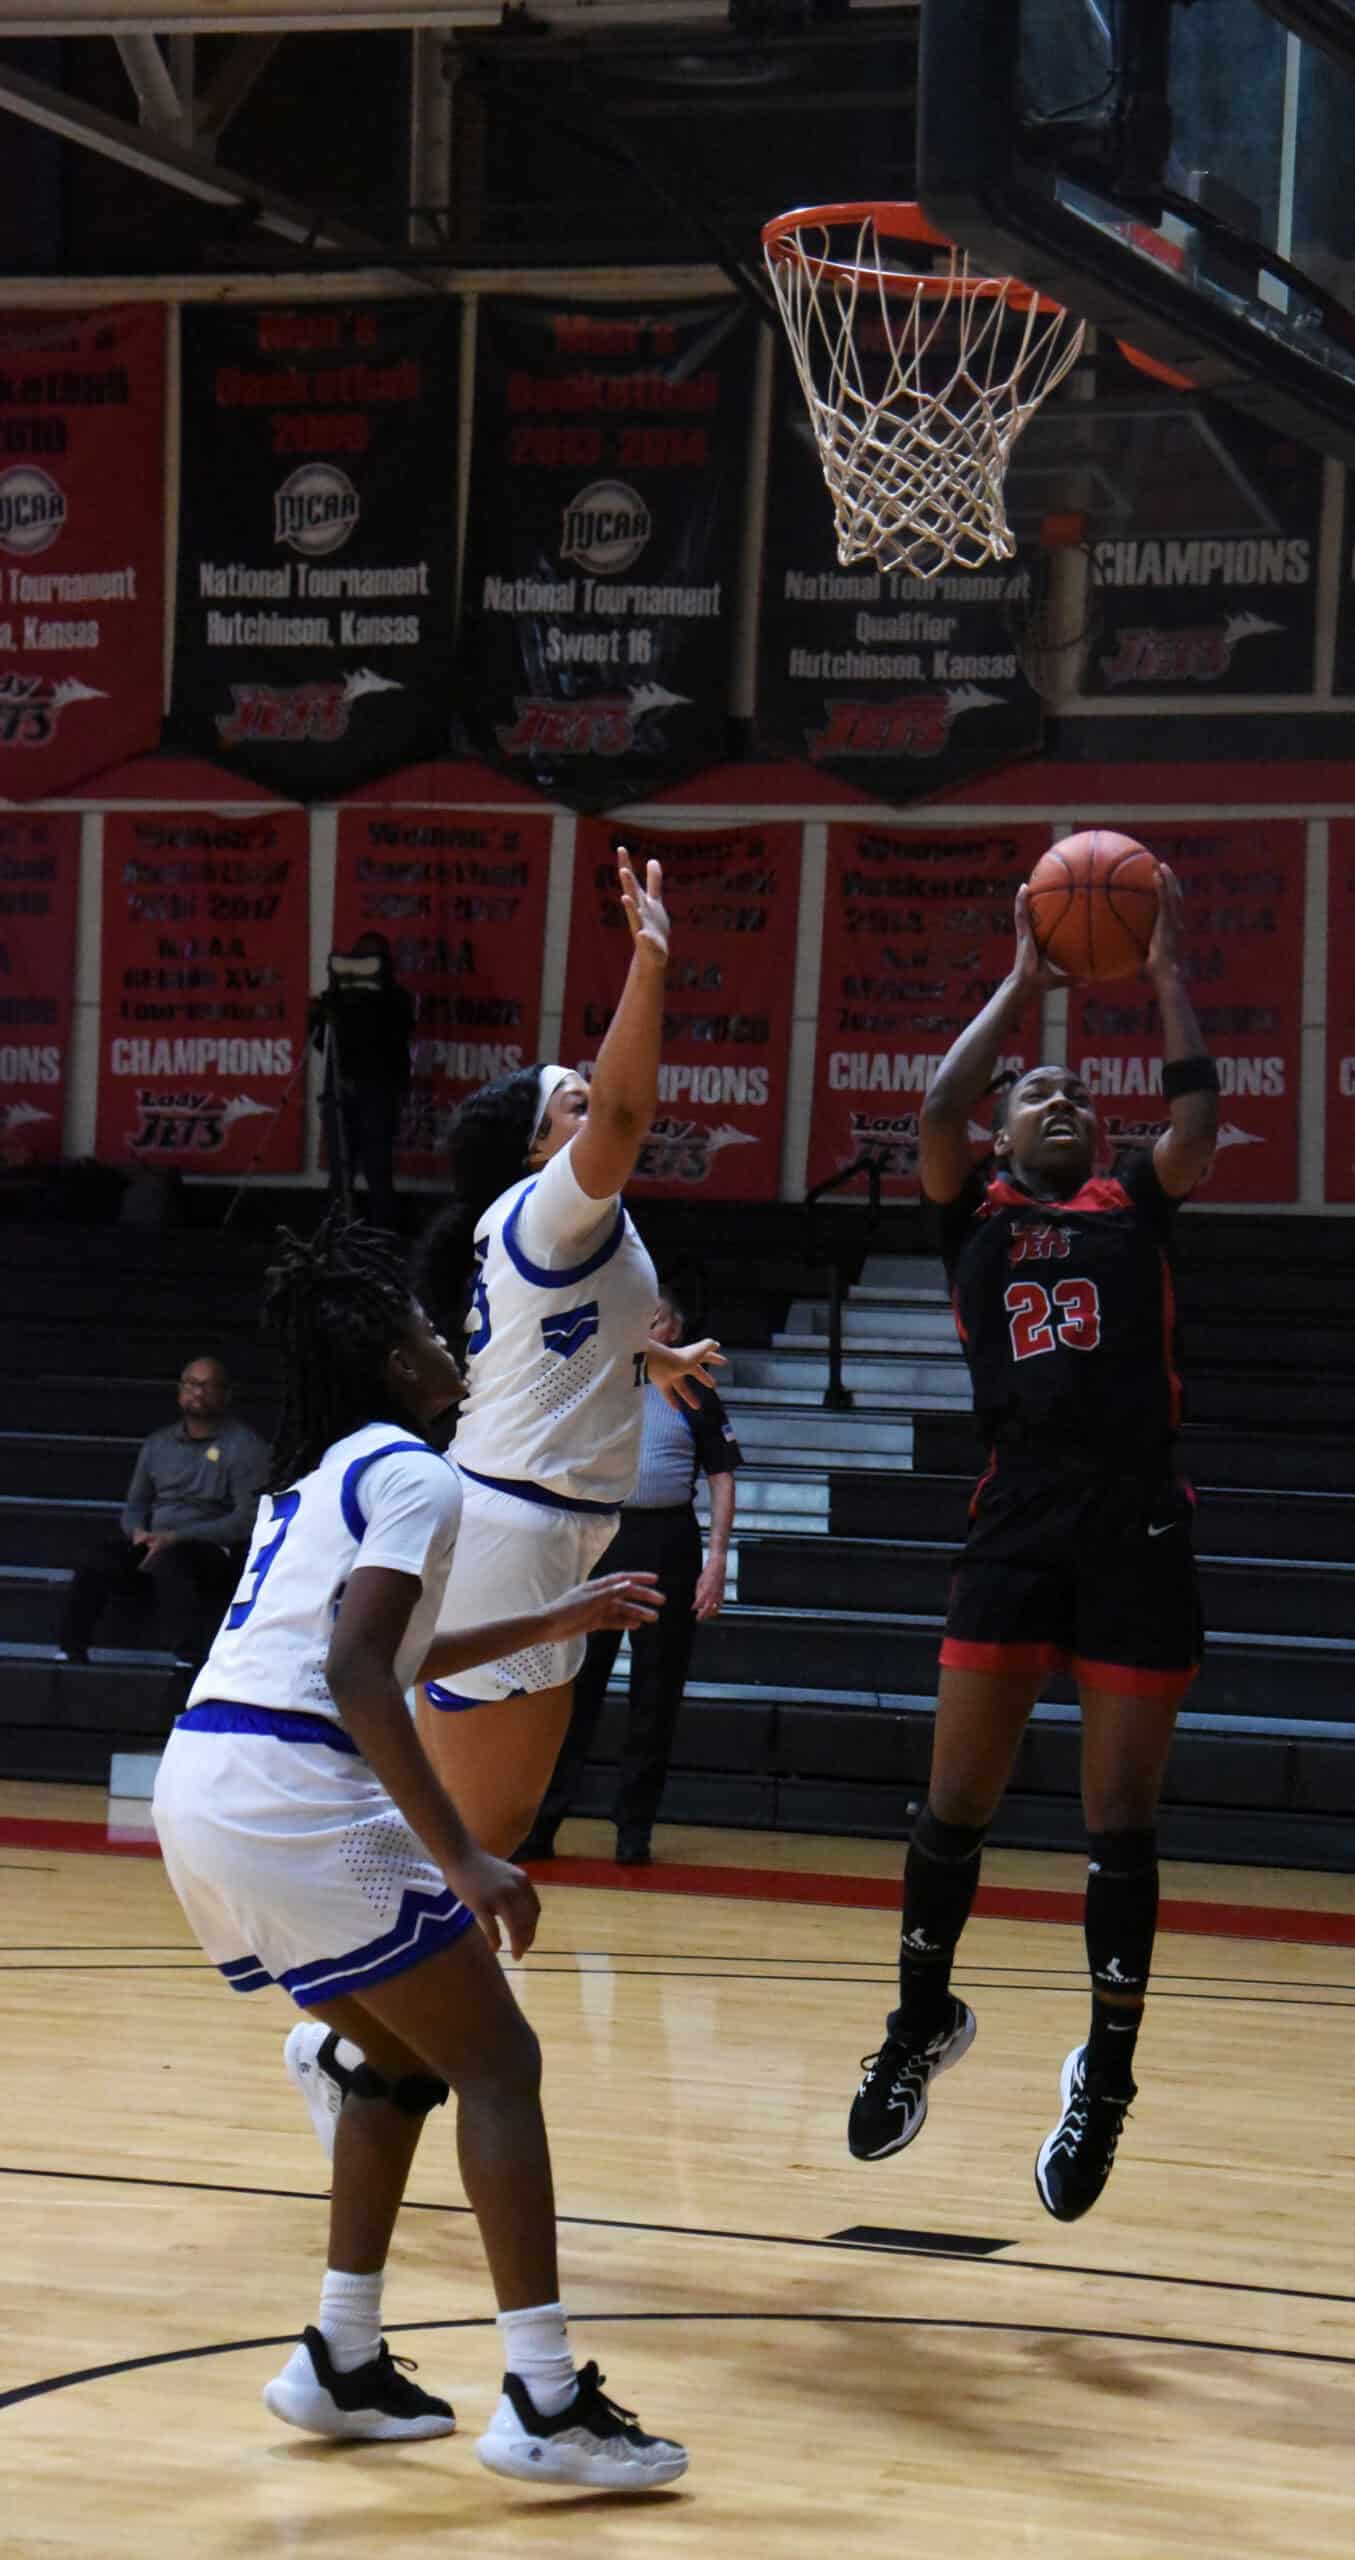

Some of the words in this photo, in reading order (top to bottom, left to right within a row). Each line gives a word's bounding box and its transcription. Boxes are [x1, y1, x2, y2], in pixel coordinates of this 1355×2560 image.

[200, 562, 292, 599] National
[296, 562, 430, 599] Tournament
[1093, 541, 1310, 586] CHAMPIONS
[8, 566, 137, 604] Tournament
[482, 576, 577, 613] National
[582, 579, 722, 616] Tournament
[784, 570, 881, 600] National
[23, 616, 100, 649] Kansas
[206, 610, 336, 648] Hutchinson,
[340, 609, 420, 646] Kansas
[544, 627, 620, 663] Sweet
[627, 629, 652, 664] 16
[856, 611, 957, 644] Qualifier
[789, 649, 928, 680] Hutchinson,
[932, 650, 1017, 680] Kansas
[110, 1037, 293, 1076] CHAMPIONS
[1080, 1056, 1286, 1096] CHAONS
[1003, 1277, 1101, 1362] 23
[226, 1489, 301, 1631] 3
